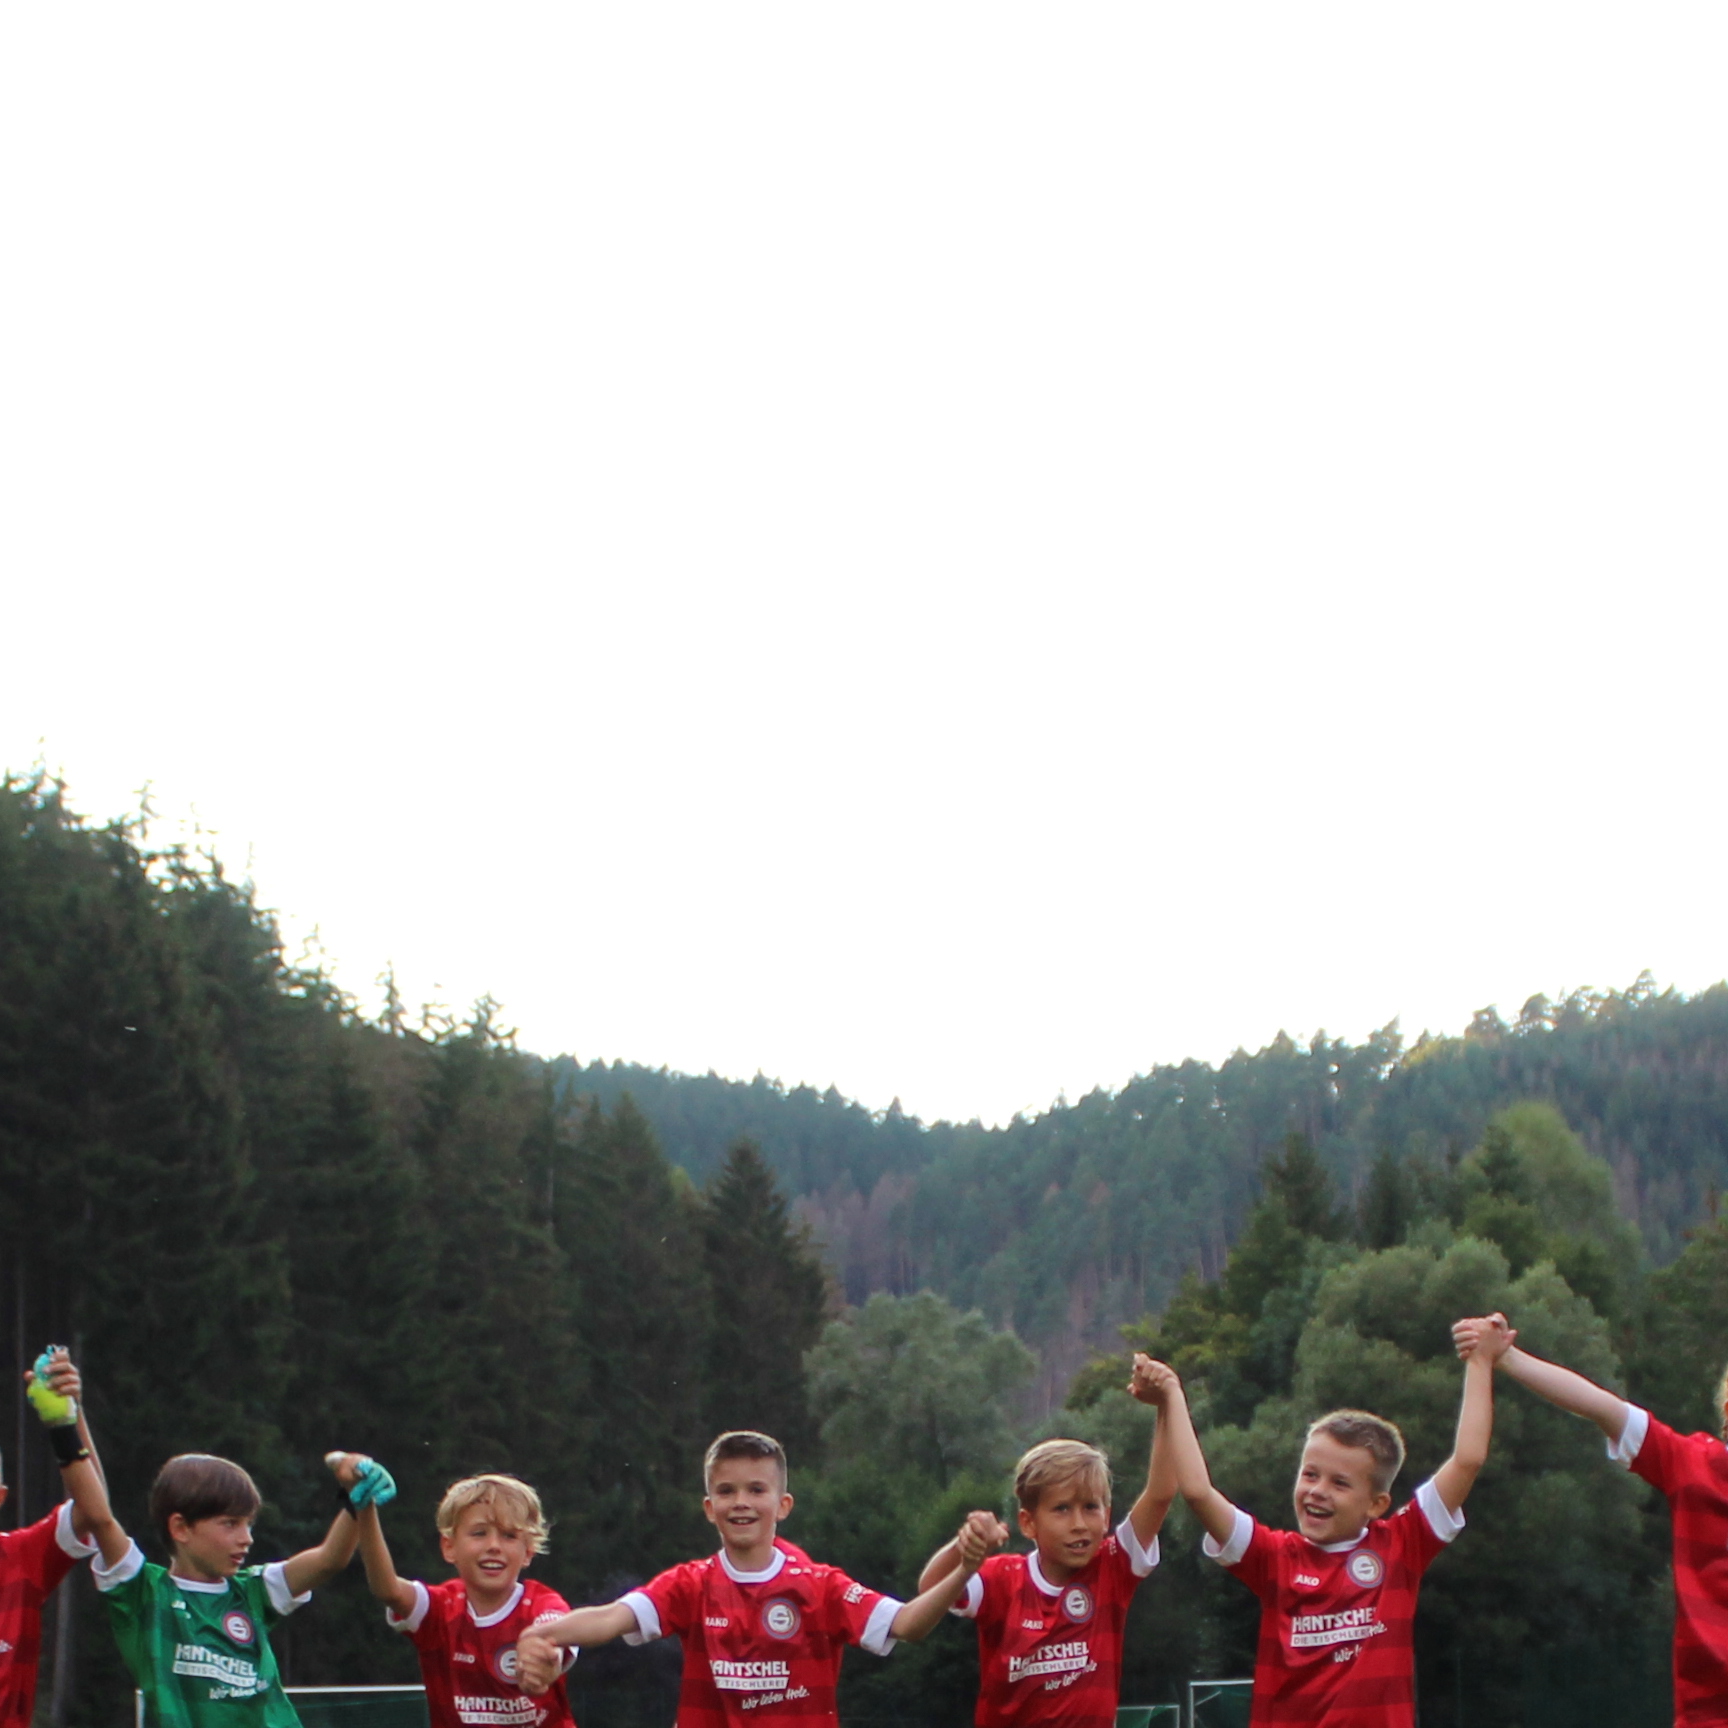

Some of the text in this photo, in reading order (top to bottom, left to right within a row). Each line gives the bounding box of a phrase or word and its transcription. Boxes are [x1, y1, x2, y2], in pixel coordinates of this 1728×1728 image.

[1294, 1574, 1320, 1587] AKO
[1022, 1619, 1044, 1630] JAKO
[1292, 1606, 1377, 1633] HANTSCHE
[1293, 1636, 1310, 1646] DIE
[1334, 1648, 1354, 1663] Wir
[724, 1678, 786, 1689] TISCHLEREI
[1045, 1678, 1062, 1691] Wir
[453, 1695, 536, 1712] HANTSCHEL
[742, 1697, 758, 1710] Wir
